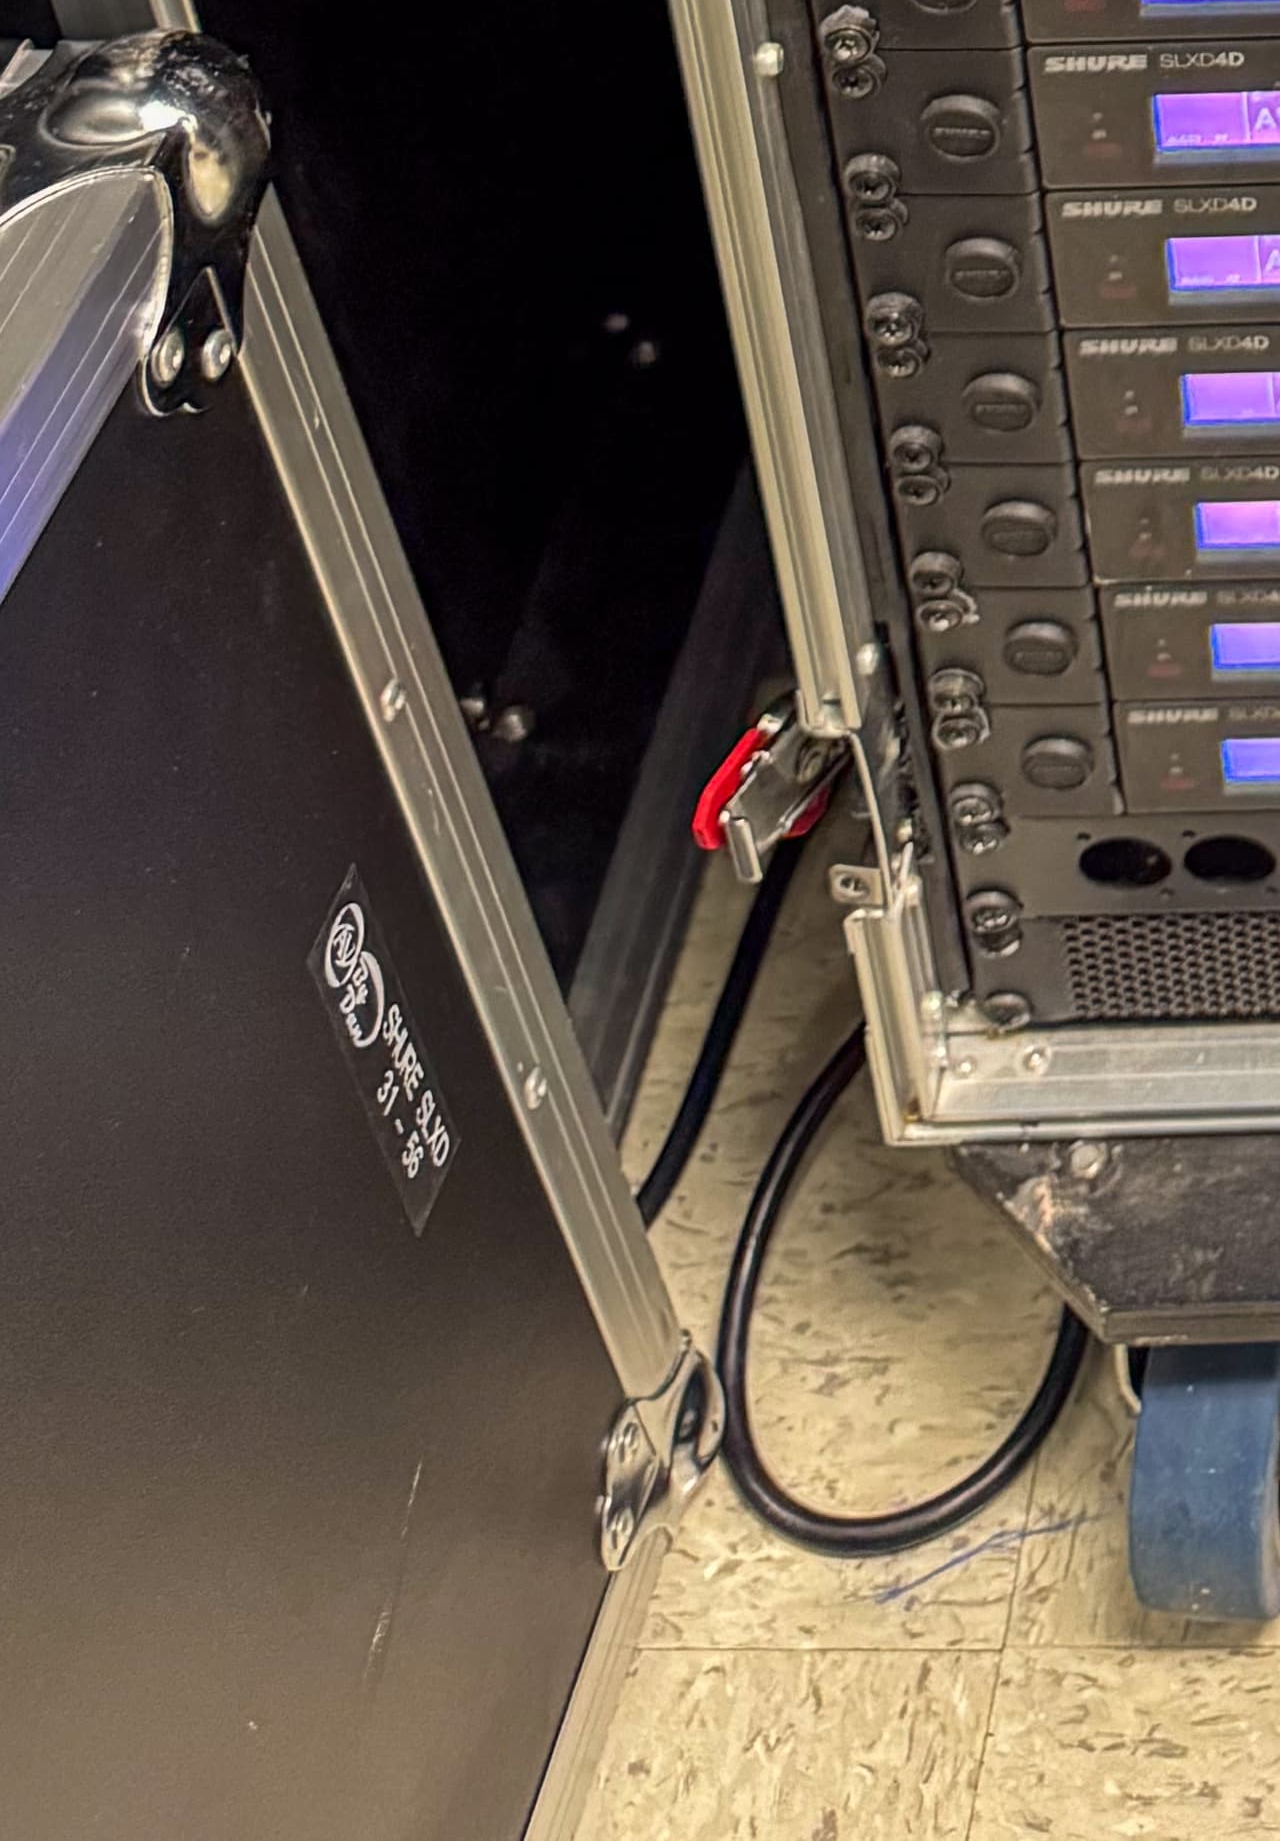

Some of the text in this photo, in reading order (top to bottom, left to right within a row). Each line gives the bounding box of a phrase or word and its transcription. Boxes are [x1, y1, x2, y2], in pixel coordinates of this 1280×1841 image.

[376, 1069, 400, 1117] 31
[382, 1003, 451, 1167] SHURE SLXD
